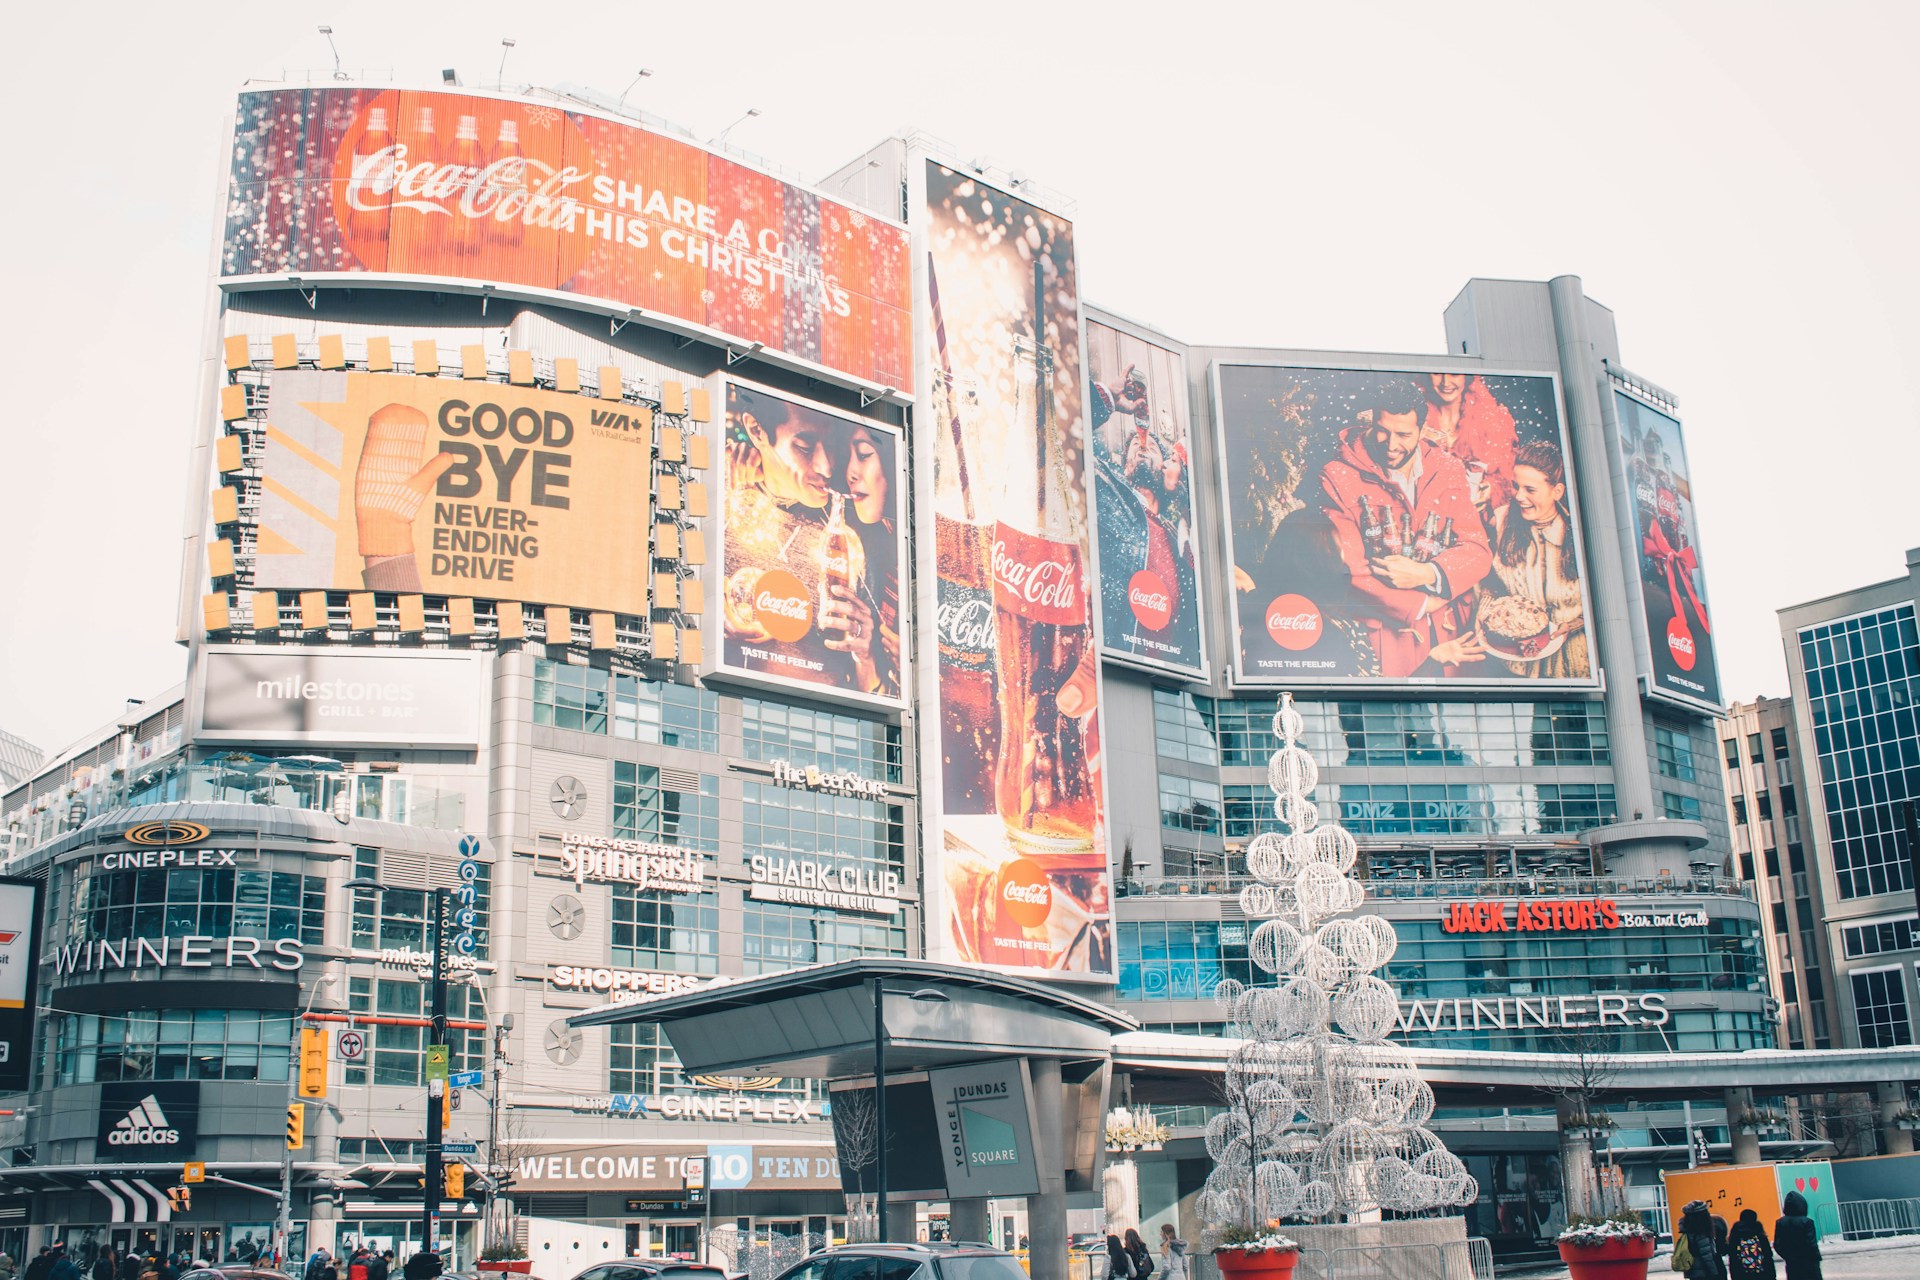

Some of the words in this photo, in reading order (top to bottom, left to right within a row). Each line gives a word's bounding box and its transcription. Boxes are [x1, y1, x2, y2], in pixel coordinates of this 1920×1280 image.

[345, 143, 592, 230] Coca-Cola
[592, 175, 717, 235] SHARE
[727, 218, 751, 249] A
[562, 204, 648, 248] THIS
[661, 230, 850, 317] CHRISTMAS
[438, 399, 574, 448] GOOD
[591, 409, 629, 431] VIA
[591, 428, 604, 437] VIA
[606, 430, 618, 440] Rail
[436, 440, 572, 510] BYE
[434, 502, 538, 533] NEVER-
[433, 528, 538, 558] ENDING
[431, 554, 514, 582] DRIVE
[992, 540, 1075, 609] Coca-Cola
[756, 590, 810, 621] Coca-Cola
[1130, 587, 1167, 613] Coca-Cola
[1268, 612, 1319, 632] Coca-Cola
[1122, 634, 1141, 645] TASTE
[1142, 638, 1154, 648] THE
[1155, 642, 1181, 655] FEELING
[740, 646, 768, 660] TASTE
[769, 652, 786, 664] THE
[787, 656, 823, 671] FEELING
[1257, 660, 1283, 668] TASTE
[256, 674, 415, 701] milestones
[318, 705, 364, 717] GRILL
[382, 707, 414, 718] BAR
[770, 758, 806, 783] The
[804, 764, 847, 791] Beer
[845, 772, 889, 797] Store
[1348, 802, 1395, 818] DMZ
[1425, 802, 1472, 818] DMZ
[562, 832, 605, 848] LOUNGE
[612, 838, 686, 858] RESTAURANT
[103, 850, 237, 870] CINEPLEX
[750, 854, 834, 891] SHARK
[840, 866, 899, 898] CLUB
[778, 888, 820, 905] SPORTS
[823, 891, 844, 908] BAR
[849, 896, 877, 912] GRILL
[1003, 880, 1049, 906] Coca-Cola
[1443, 902, 1507, 933] JACK
[1516, 898, 1620, 931] ASTOR'S
[1622, 912, 1650, 928] Bar
[1652, 912, 1675, 927] and
[1678, 911, 1709, 928] Grill
[440, 896, 450, 981] DOWNTOWN
[993, 937, 1018, 948] TASTE
[1018, 940, 1034, 950] THE
[55, 936, 304, 976] WINNERS
[553, 966, 700, 992] SHOPPERS
[1143, 967, 1222, 994] DMZ
[1394, 992, 1669, 1033] WINNERS
[960, 1082, 1007, 1097] DUNDAS
[609, 1094, 649, 1114] AVX
[661, 1095, 810, 1120] CINEPLEX
[108, 1126, 180, 1145] adidas
[948, 1110, 964, 1168] YONGE
[519, 1156, 657, 1179] WELCOME
[711, 1154, 748, 1181] 10
[759, 1157, 809, 1178] TEN
[972, 1149, 1016, 1165] SQUARE
[640, 1202, 664, 1210] Dundas
